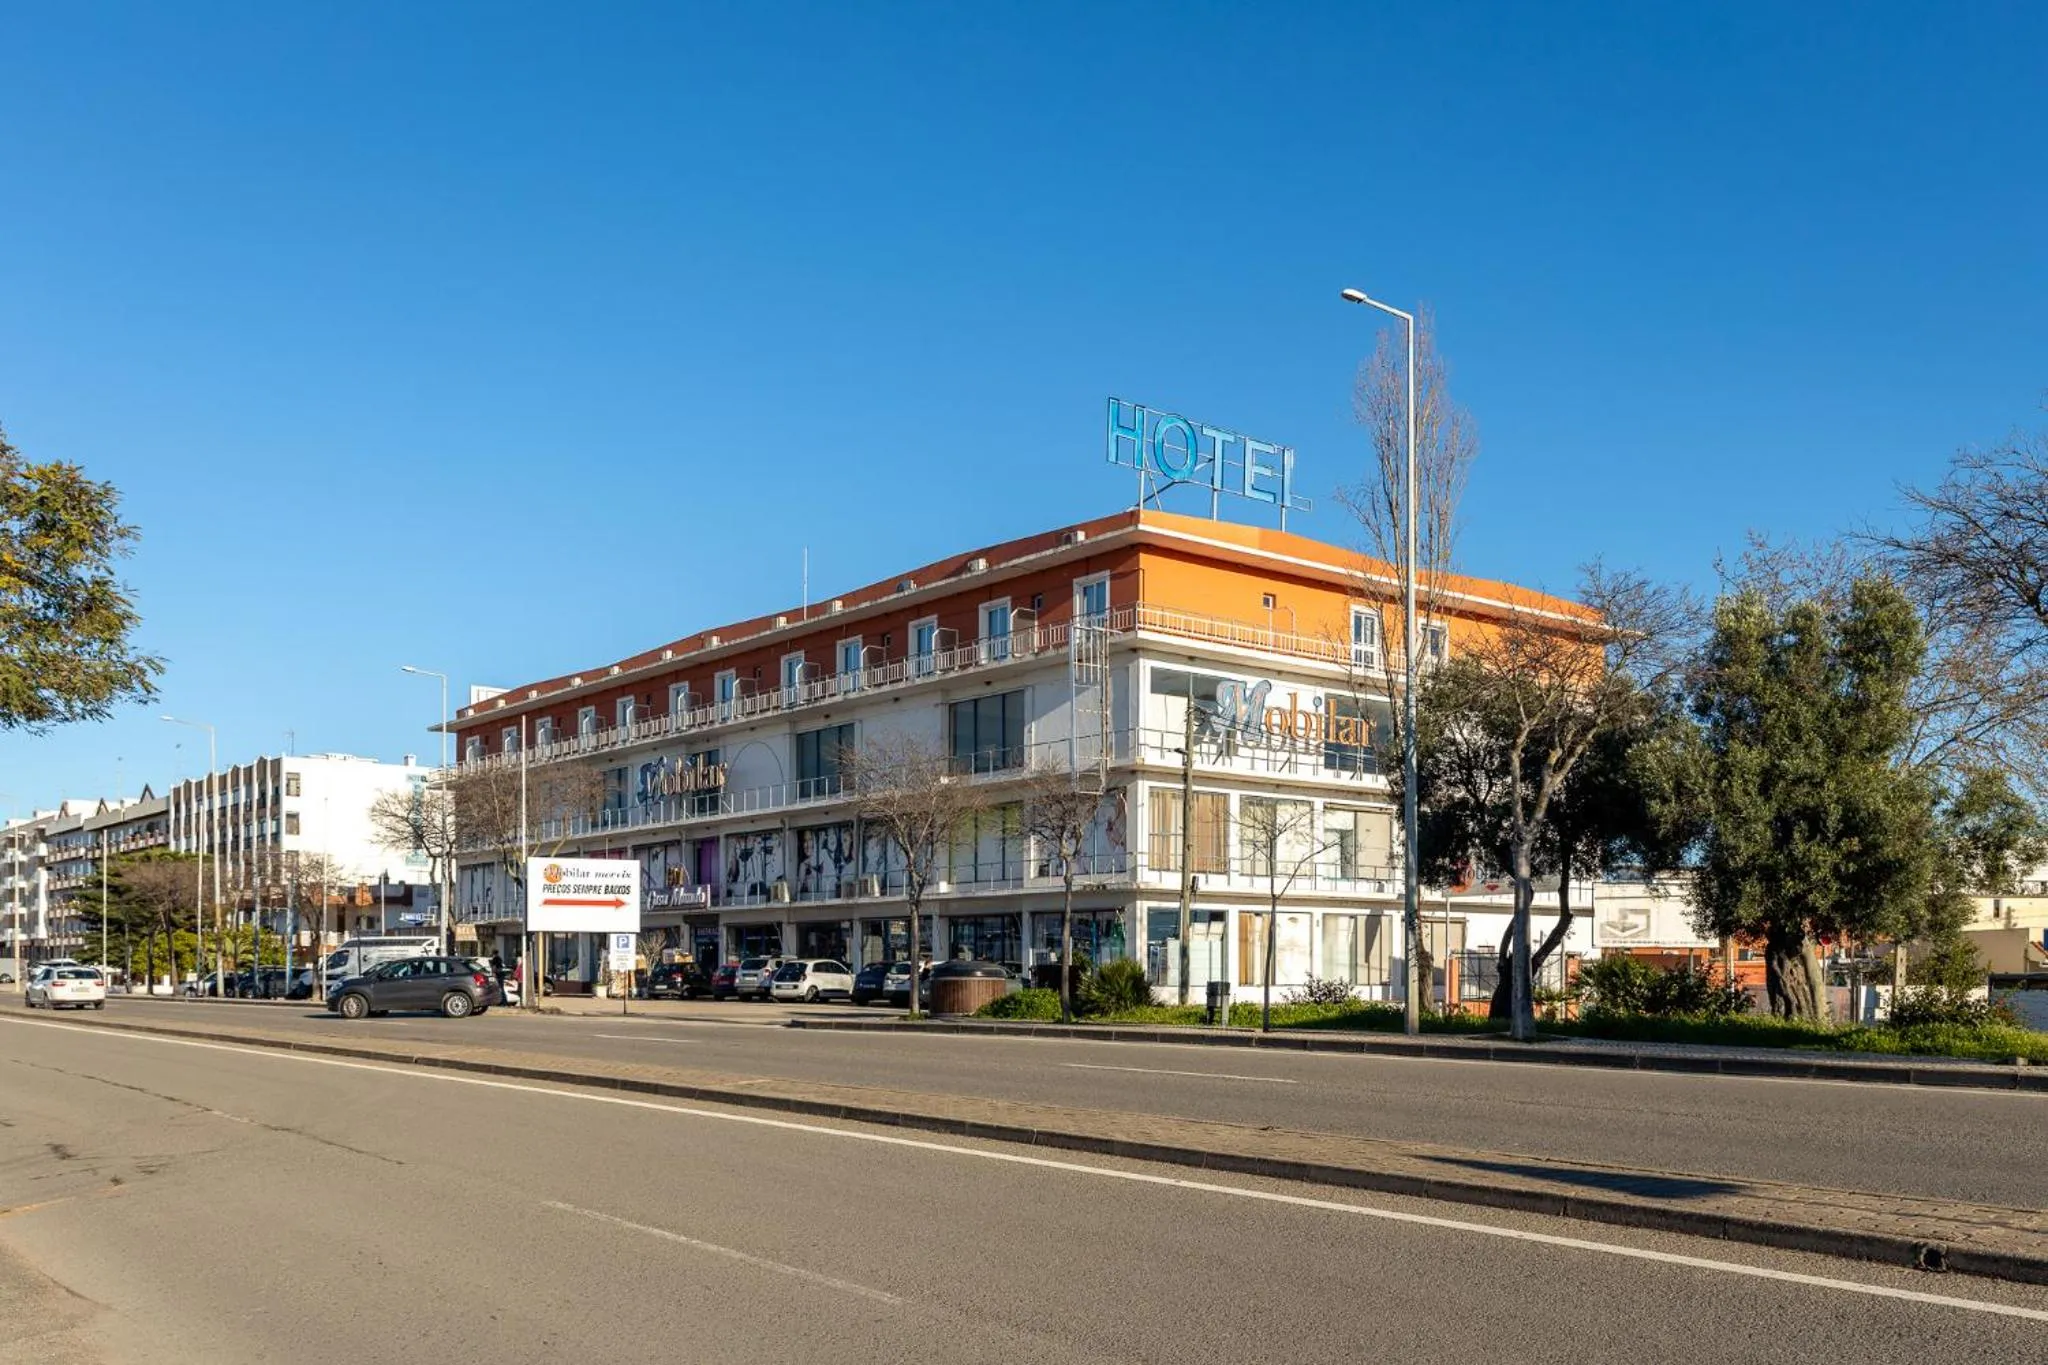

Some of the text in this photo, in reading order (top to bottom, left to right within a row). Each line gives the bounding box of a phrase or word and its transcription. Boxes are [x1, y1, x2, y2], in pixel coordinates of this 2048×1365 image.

[1210, 680, 1376, 746] Mobilar
[572, 884, 602, 895] SEMPRE
[604, 885, 631, 895] BAIXOS
[618, 937, 628, 948] P
